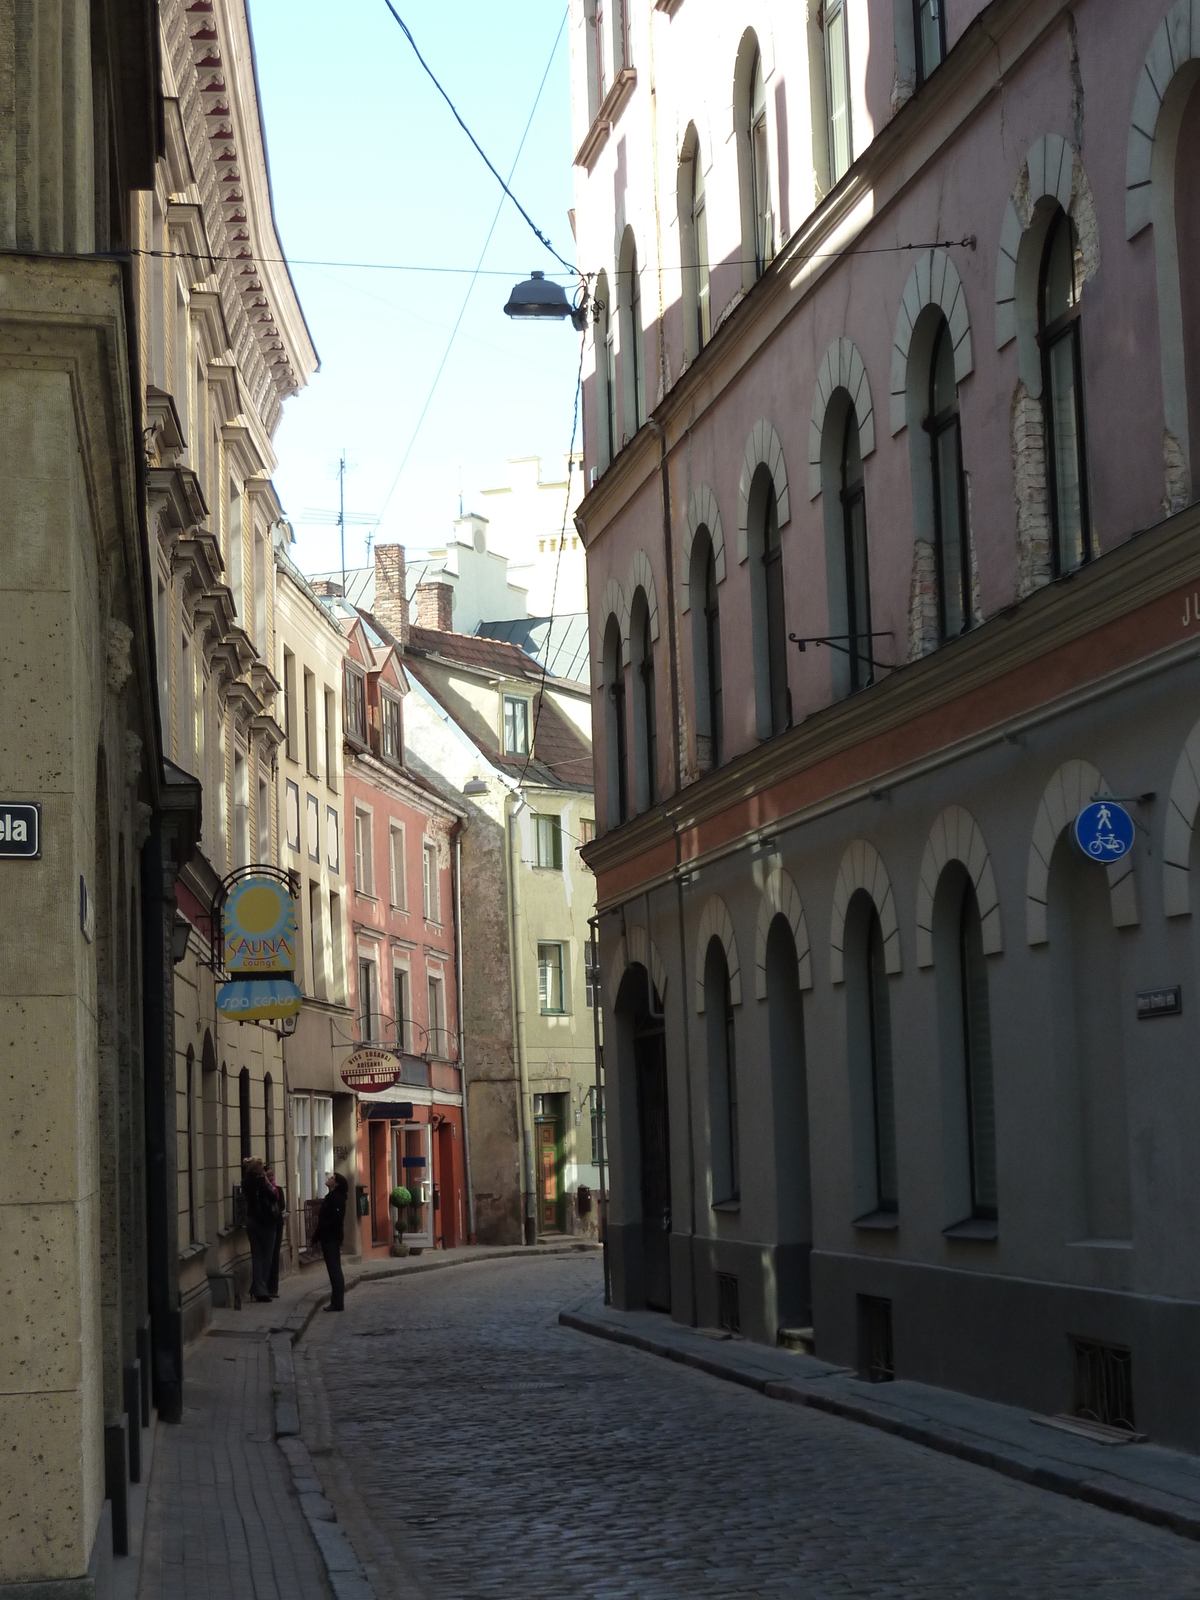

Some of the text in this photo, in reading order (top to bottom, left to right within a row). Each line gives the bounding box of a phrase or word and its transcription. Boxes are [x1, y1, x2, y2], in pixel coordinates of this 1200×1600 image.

[228, 937, 292, 960] SAUNA
[221, 995, 297, 1009] spa centrs
